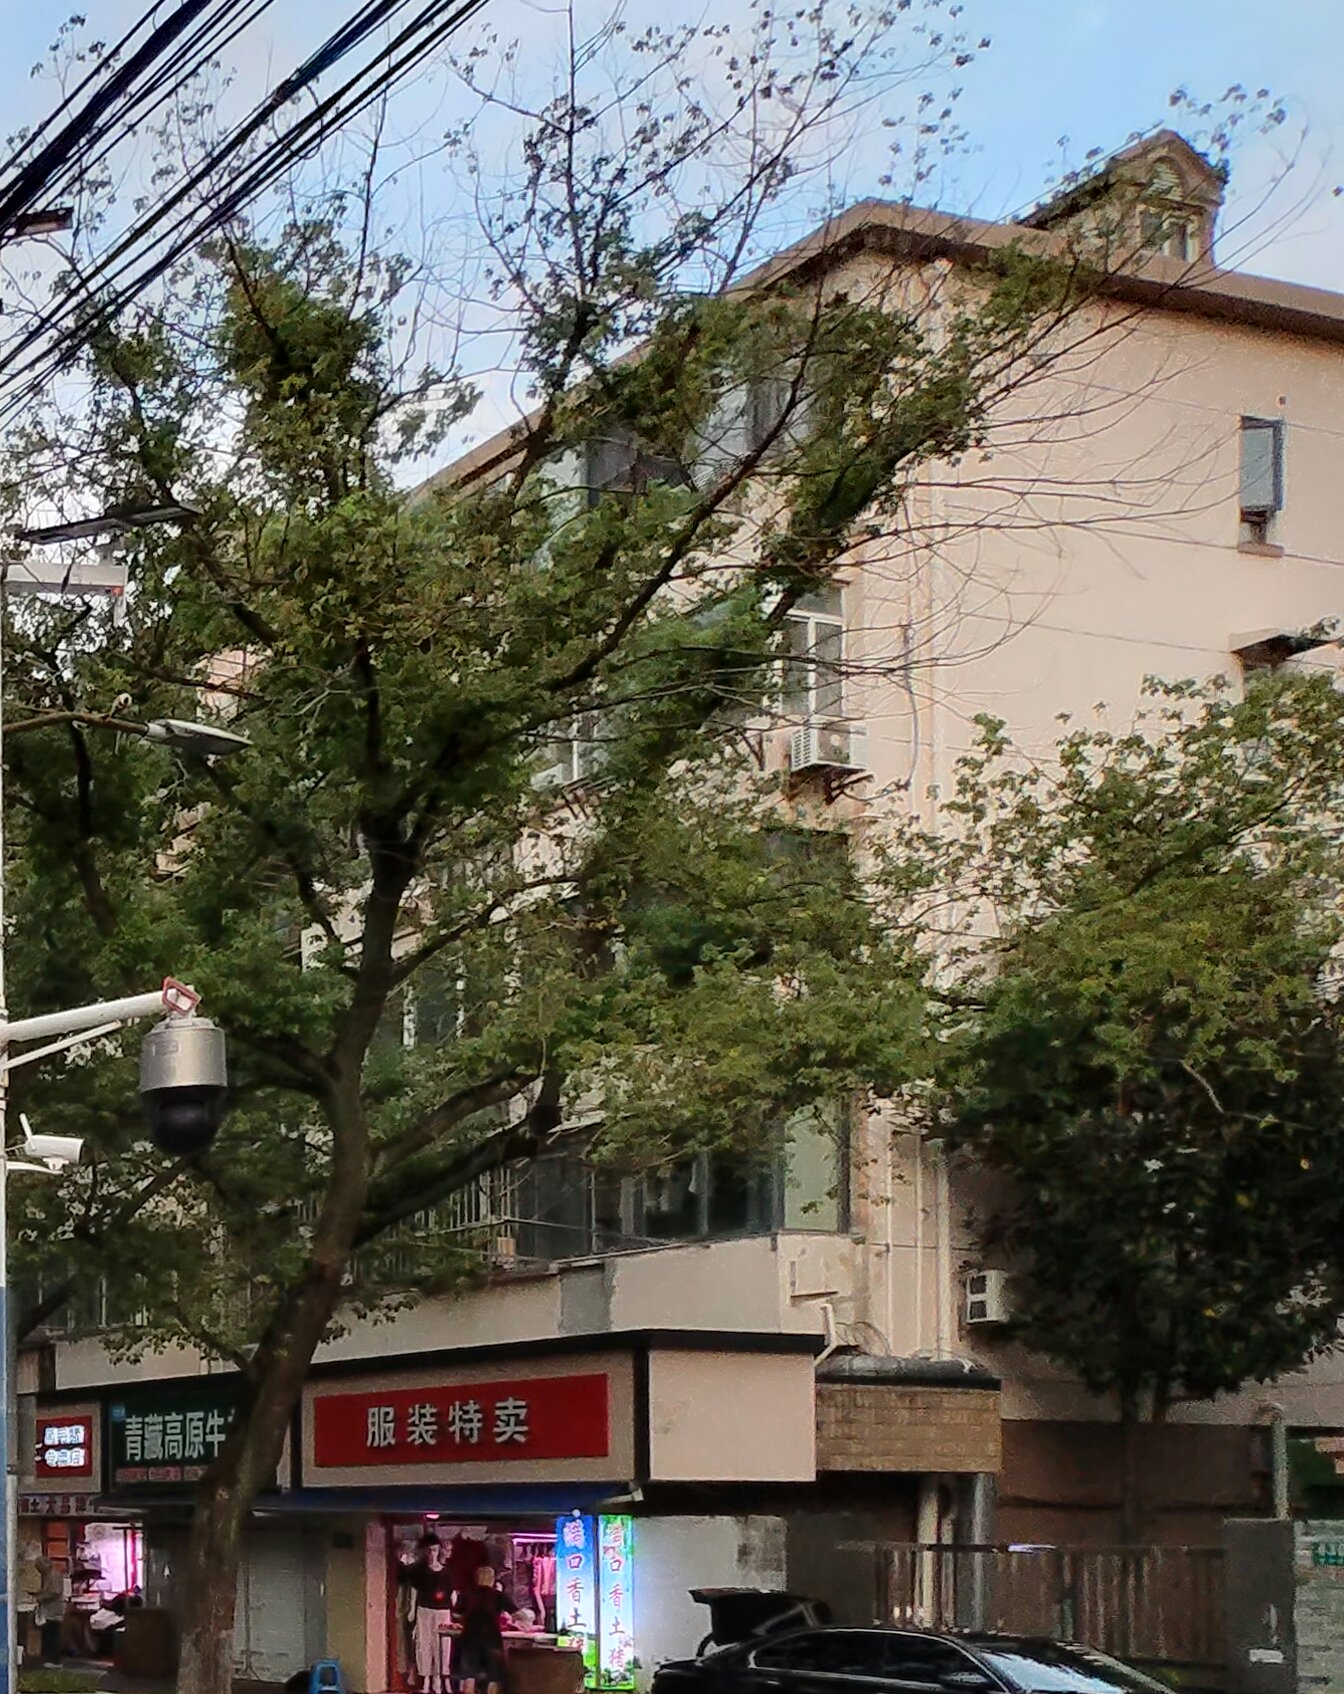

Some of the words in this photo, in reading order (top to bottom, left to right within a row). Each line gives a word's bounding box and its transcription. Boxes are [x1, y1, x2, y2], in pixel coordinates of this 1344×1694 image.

[124, 1407, 236, 1461] 青藏高原牛
[366, 1397, 529, 1447] 服装特卖
